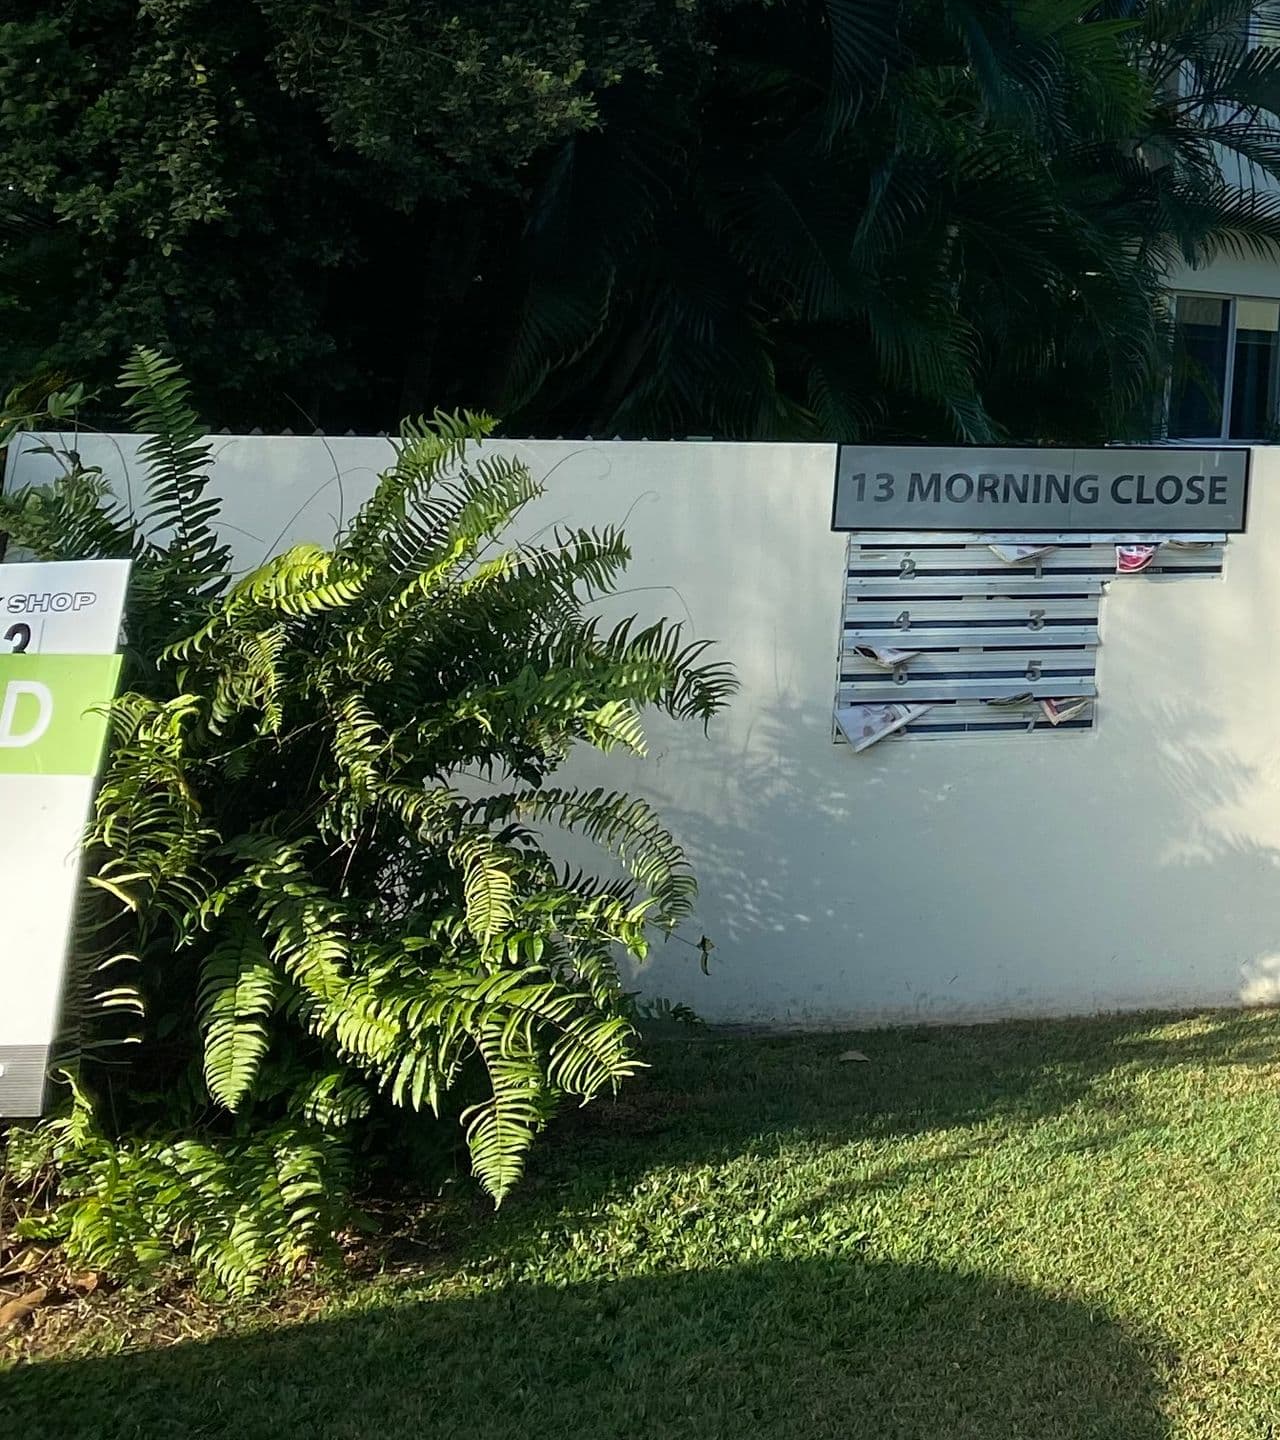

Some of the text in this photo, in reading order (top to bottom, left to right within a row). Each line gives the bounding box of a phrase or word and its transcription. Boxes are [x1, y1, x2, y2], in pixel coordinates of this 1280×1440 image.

[851, 471, 1228, 505] 13 MORNING CLOSE
[899, 558, 916, 580] 2
[7, 591, 97, 614] SHOP
[895, 610, 912, 632] 4
[1027, 609, 1046, 631] 3
[893, 663, 909, 686] 6
[1025, 660, 1042, 682] 5
[1022, 711, 1040, 734] 7
